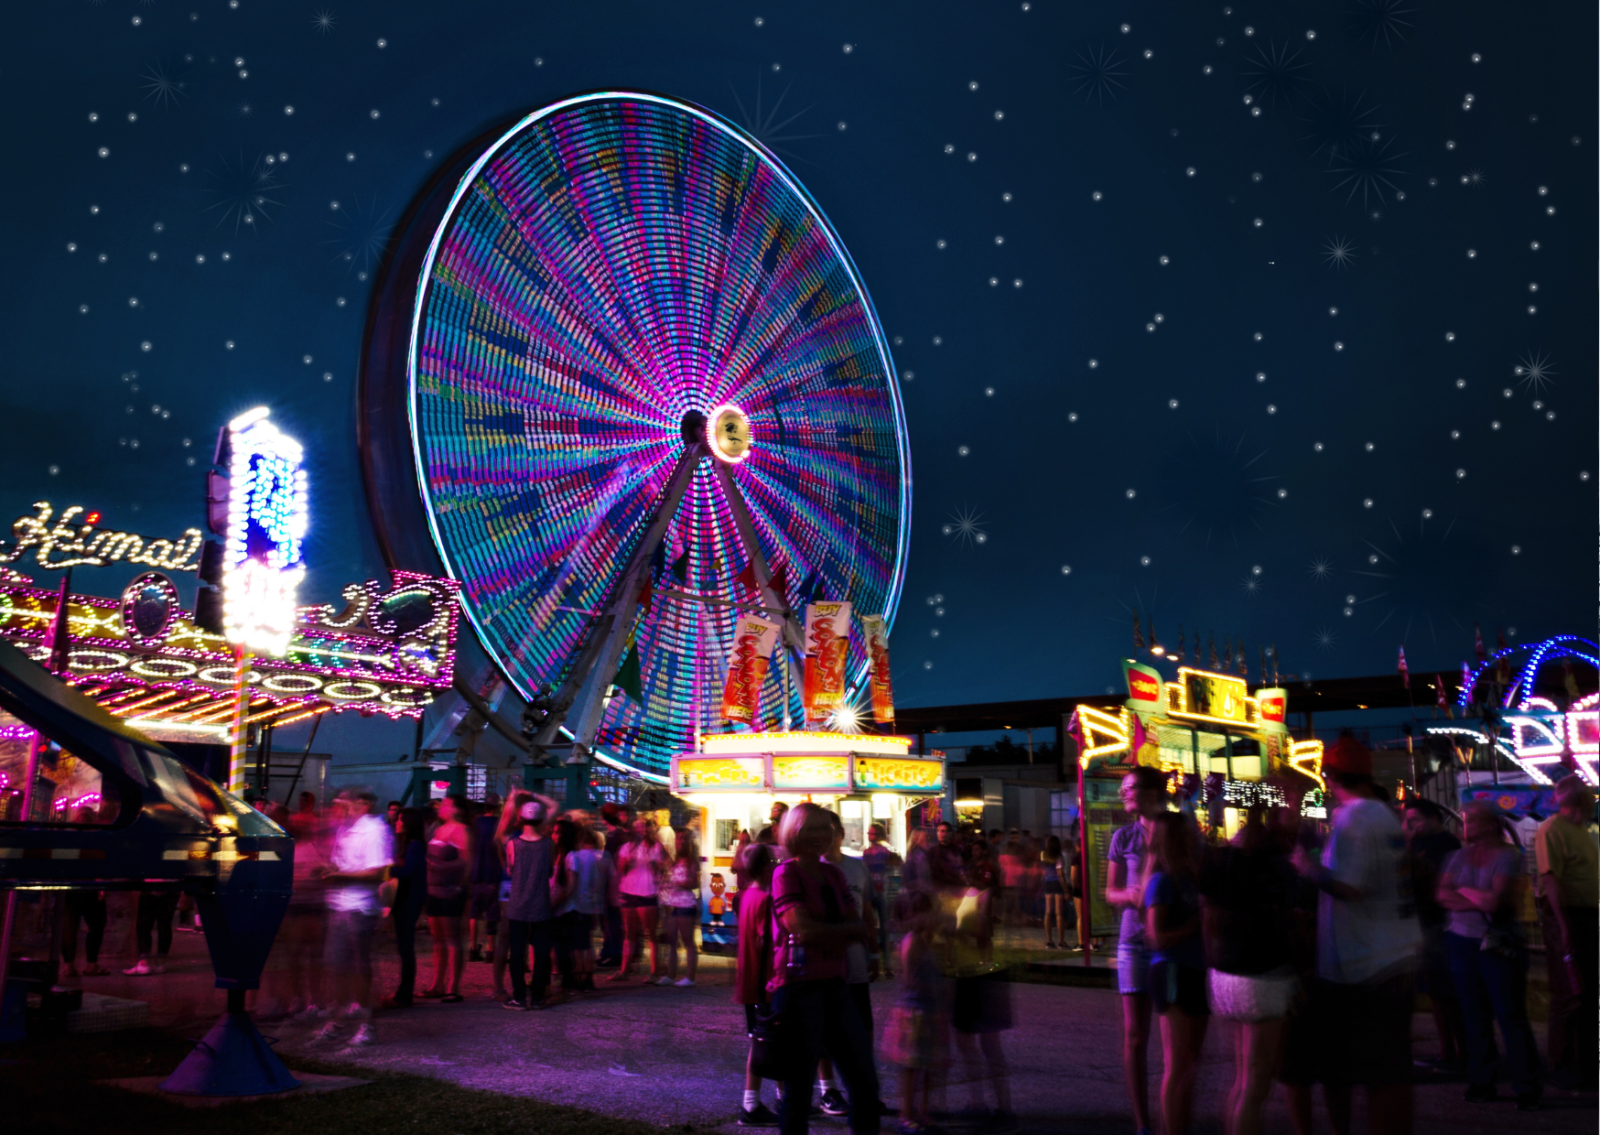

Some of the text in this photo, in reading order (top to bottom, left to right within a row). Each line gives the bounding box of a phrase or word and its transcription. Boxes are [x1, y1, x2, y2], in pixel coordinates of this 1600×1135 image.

[814, 604, 842, 618] BUY
[744, 623, 769, 637] BUY
[811, 617, 845, 693] COUPONS
[728, 705, 754, 720] HERE
[871, 761, 927, 787] TICKETS
